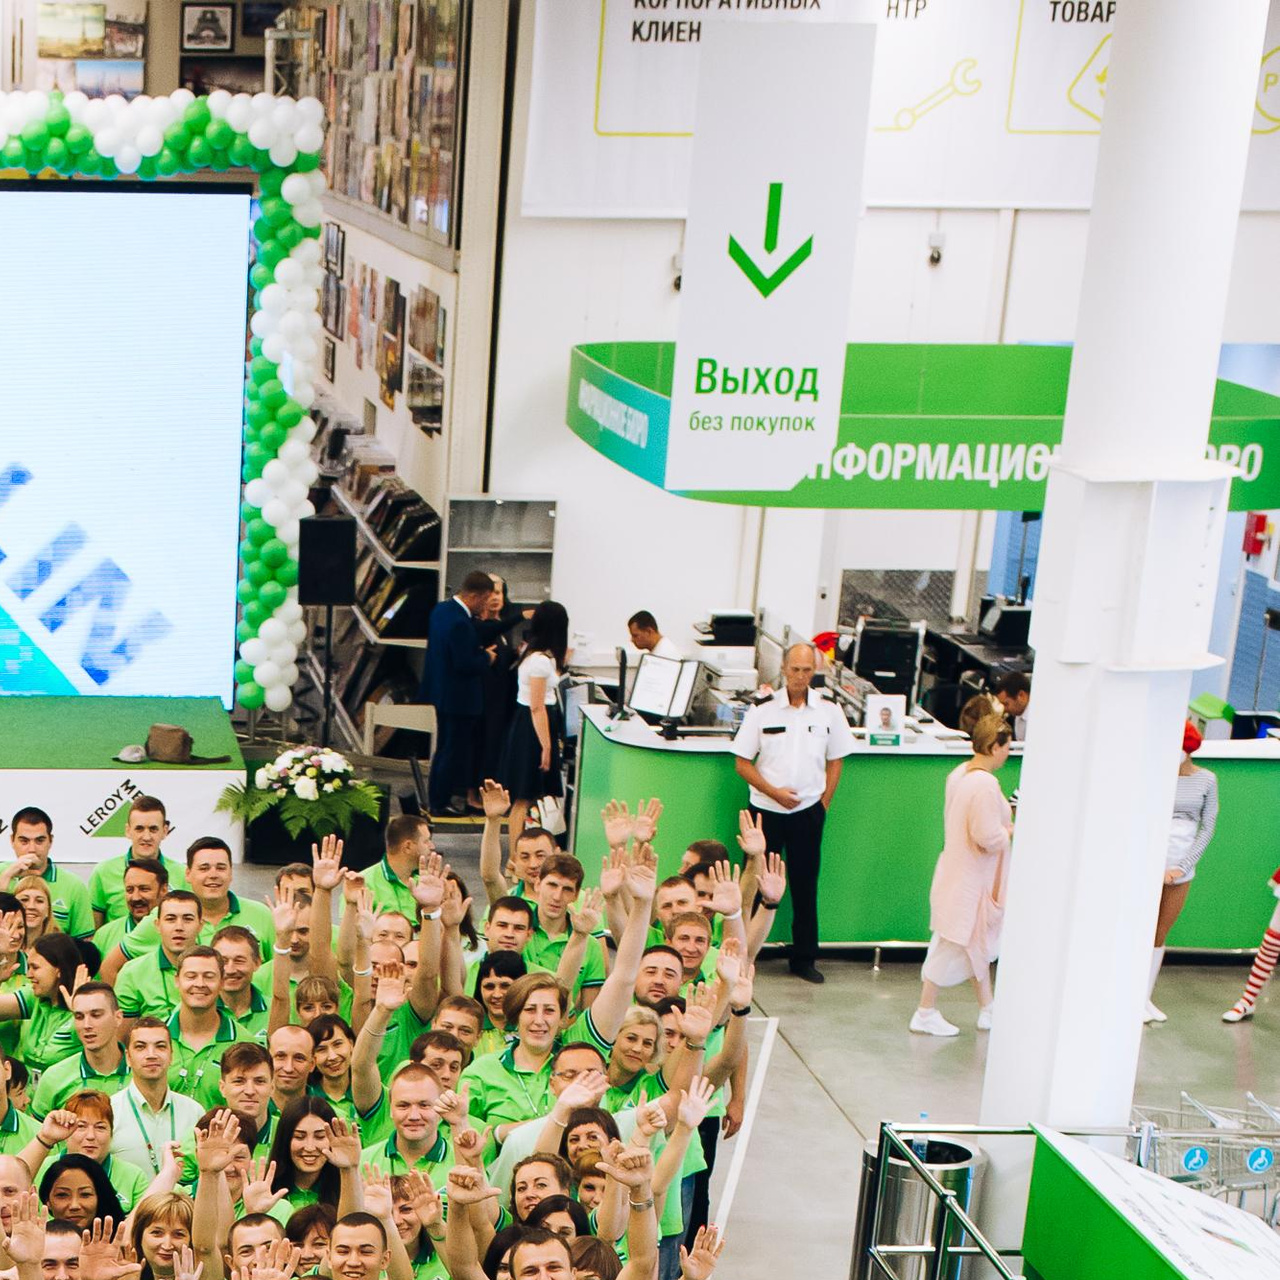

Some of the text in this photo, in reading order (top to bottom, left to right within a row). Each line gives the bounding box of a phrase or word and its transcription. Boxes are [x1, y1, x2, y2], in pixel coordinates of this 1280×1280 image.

[631, 21, 702, 42] КЛИЕН
[694, 357, 820, 402] Выход
[688, 411, 817, 436] без покупок
[79, 788, 124, 836] LEROY
